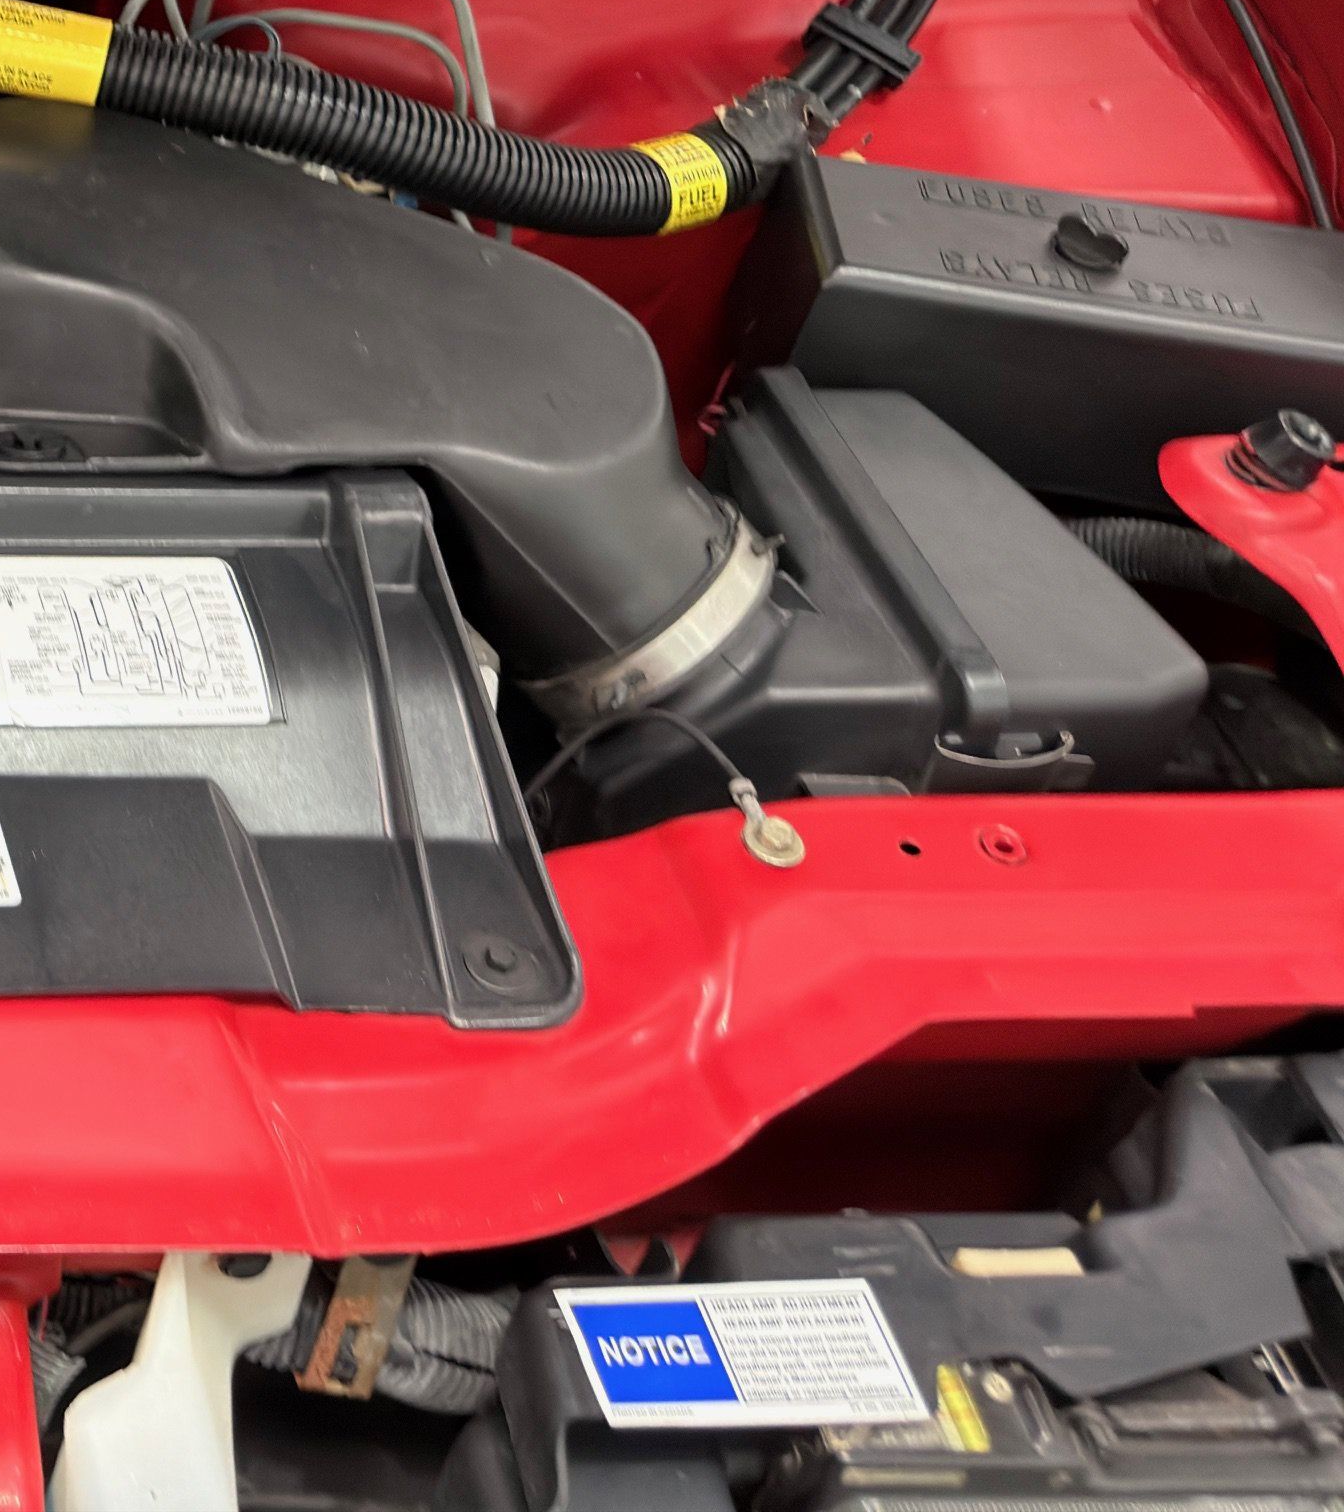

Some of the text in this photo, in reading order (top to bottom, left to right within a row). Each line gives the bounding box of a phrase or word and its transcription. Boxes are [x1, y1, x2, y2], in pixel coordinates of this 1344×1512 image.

[674, 164, 721, 186] CAUTION
[678, 184, 716, 208] FUEL
[710, 1295, 860, 1313] HEADLAMP ADJUSTMENT
[597, 1334, 712, 1368] NOTICE
